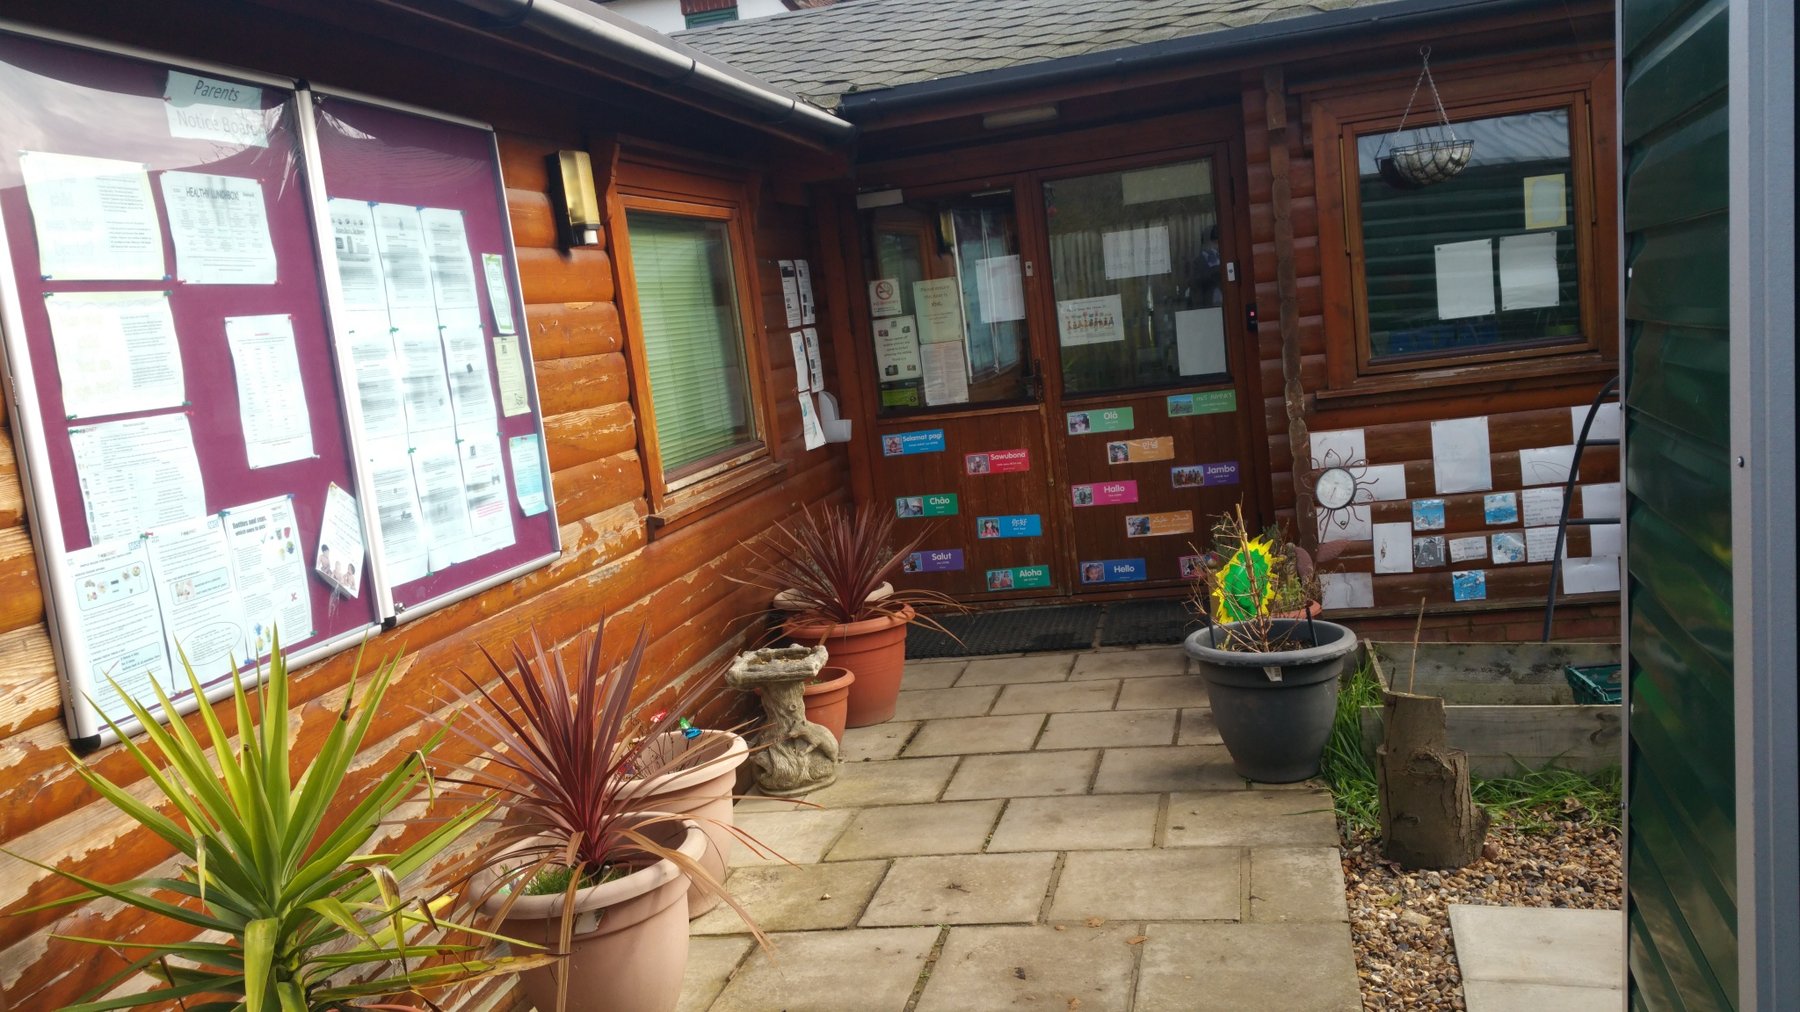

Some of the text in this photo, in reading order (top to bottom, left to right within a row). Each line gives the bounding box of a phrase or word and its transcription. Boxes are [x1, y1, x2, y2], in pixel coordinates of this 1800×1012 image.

[194, 80, 240, 102] Parents
[176, 109, 220, 131] Notice
[902, 432, 943, 442] Selamat pagi
[990, 452, 1026, 461] Sawubona
[1206, 464, 1236, 475] Jambo
[1103, 484, 1125, 493] Hallo
[931, 552, 952, 561] Salut
[1019, 568, 1042, 578] Aloha
[1114, 565, 1135, 573] Hello
